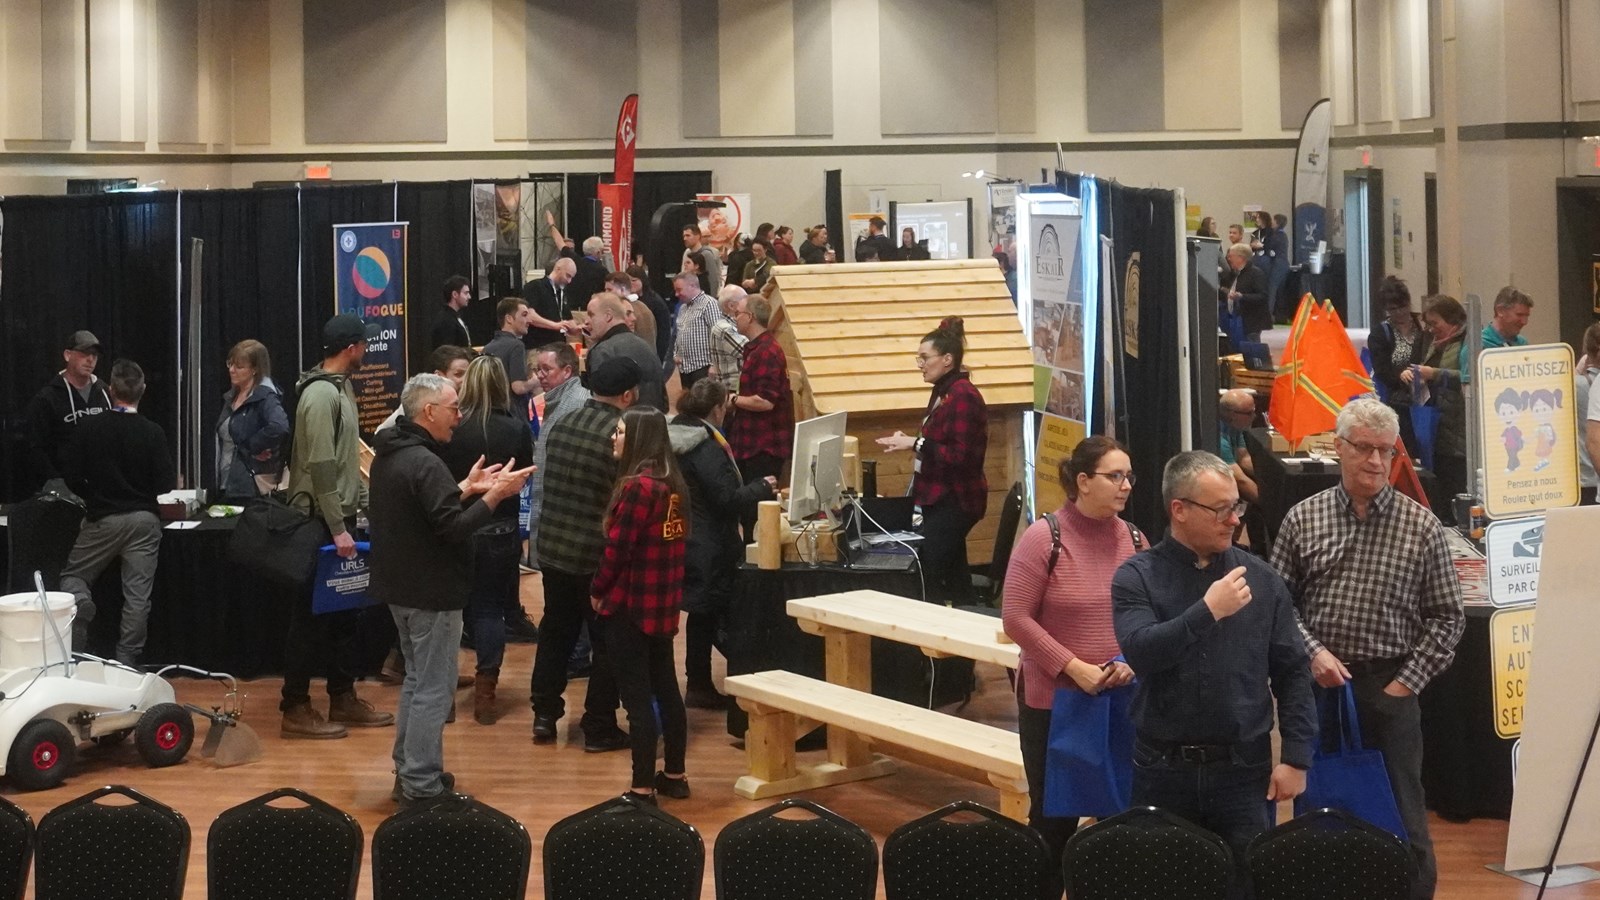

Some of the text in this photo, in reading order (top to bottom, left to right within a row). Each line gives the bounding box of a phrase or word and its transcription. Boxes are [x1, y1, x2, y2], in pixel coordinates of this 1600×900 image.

[602, 207, 613, 253] UMMOND
[366, 342, 388, 352] ente
[1485, 361, 1569, 380] RALENTISSEZ!
[1507, 481, 1532, 489] Pensez
[1541, 477, 1557, 485] nous
[1503, 495, 1527, 505] Roulez
[1545, 491, 1563, 500] doux
[341, 559, 365, 571] URLS
[1501, 563, 1540, 577] SURVEIL
[1508, 580, 1536, 594] PAR C
[1512, 623, 1534, 643] EN
[1508, 651, 1531, 672] AU
[1506, 679, 1523, 698] SC
